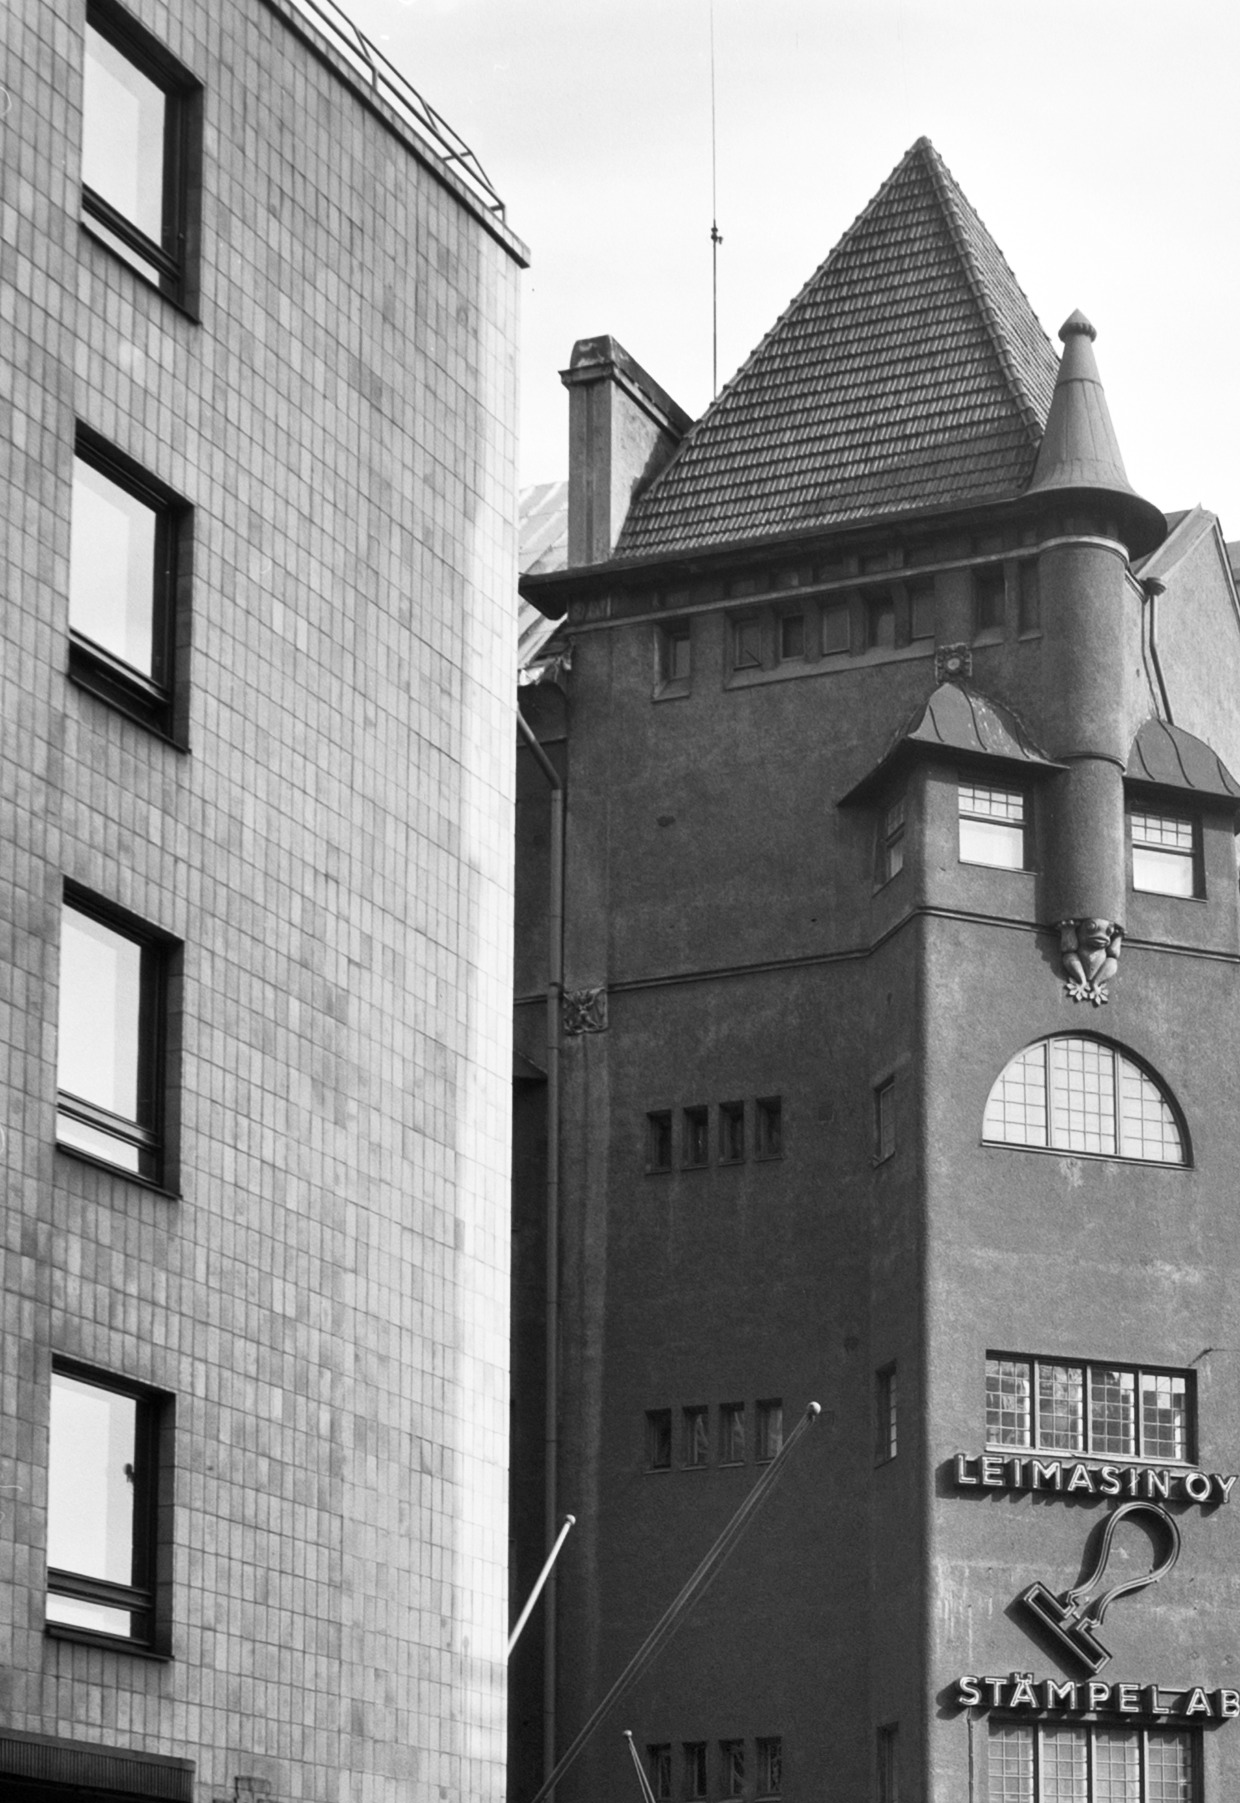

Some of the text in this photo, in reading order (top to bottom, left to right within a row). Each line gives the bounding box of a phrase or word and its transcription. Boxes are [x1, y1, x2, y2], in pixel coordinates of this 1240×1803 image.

[956, 1454, 1240, 1505] LEIMASIN OY
[957, 1672, 1173, 1715] STÄMPEL
